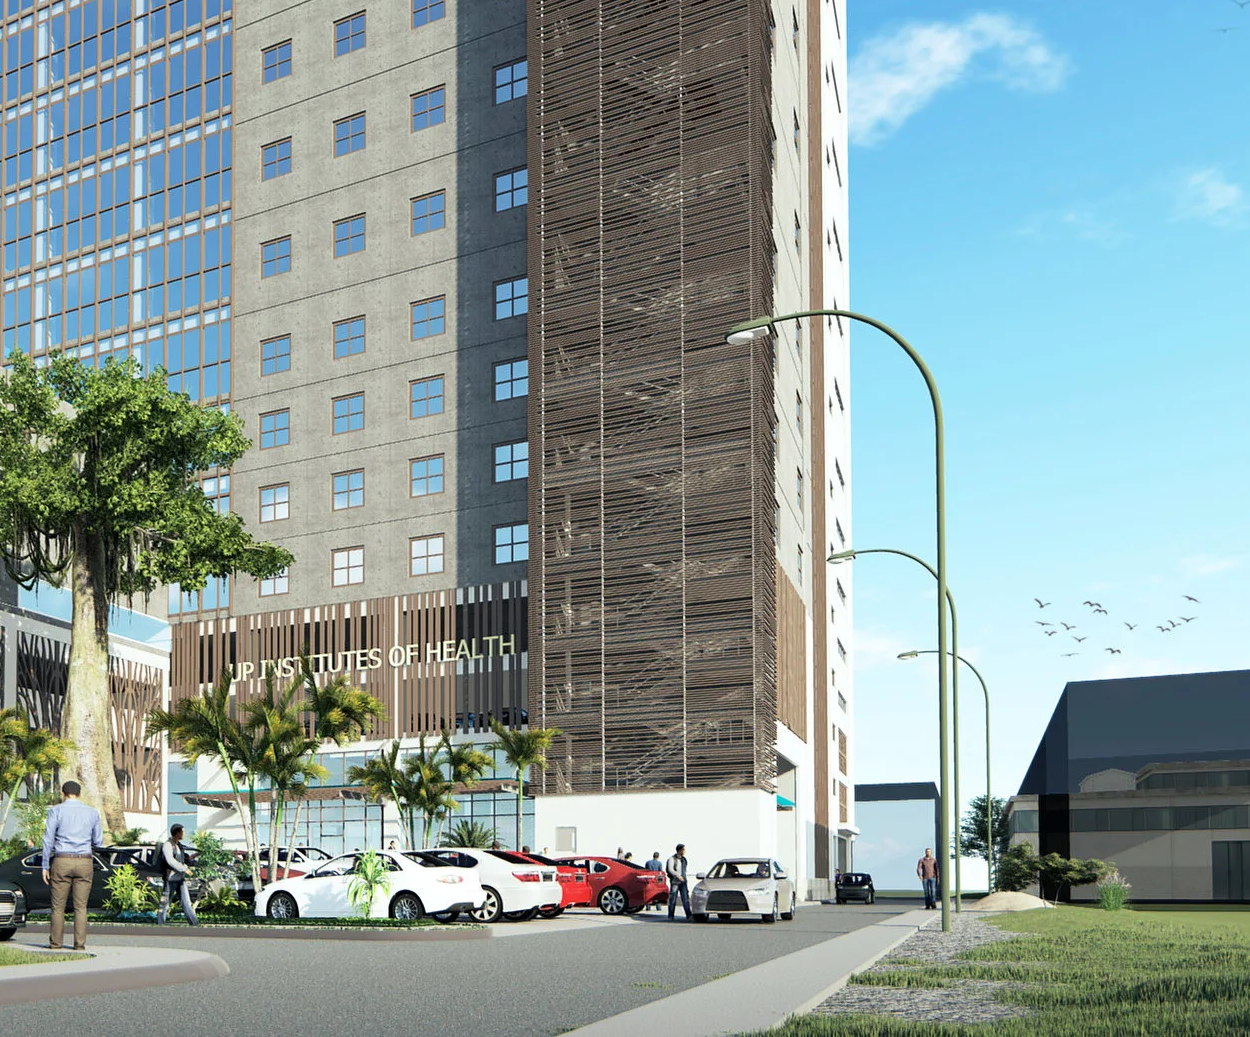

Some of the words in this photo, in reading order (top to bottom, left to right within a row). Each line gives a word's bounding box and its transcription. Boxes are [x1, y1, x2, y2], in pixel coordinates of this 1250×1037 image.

[228, 661, 254, 683] UP
[389, 644, 419, 668] OF
[426, 633, 515, 664] HEALTH
